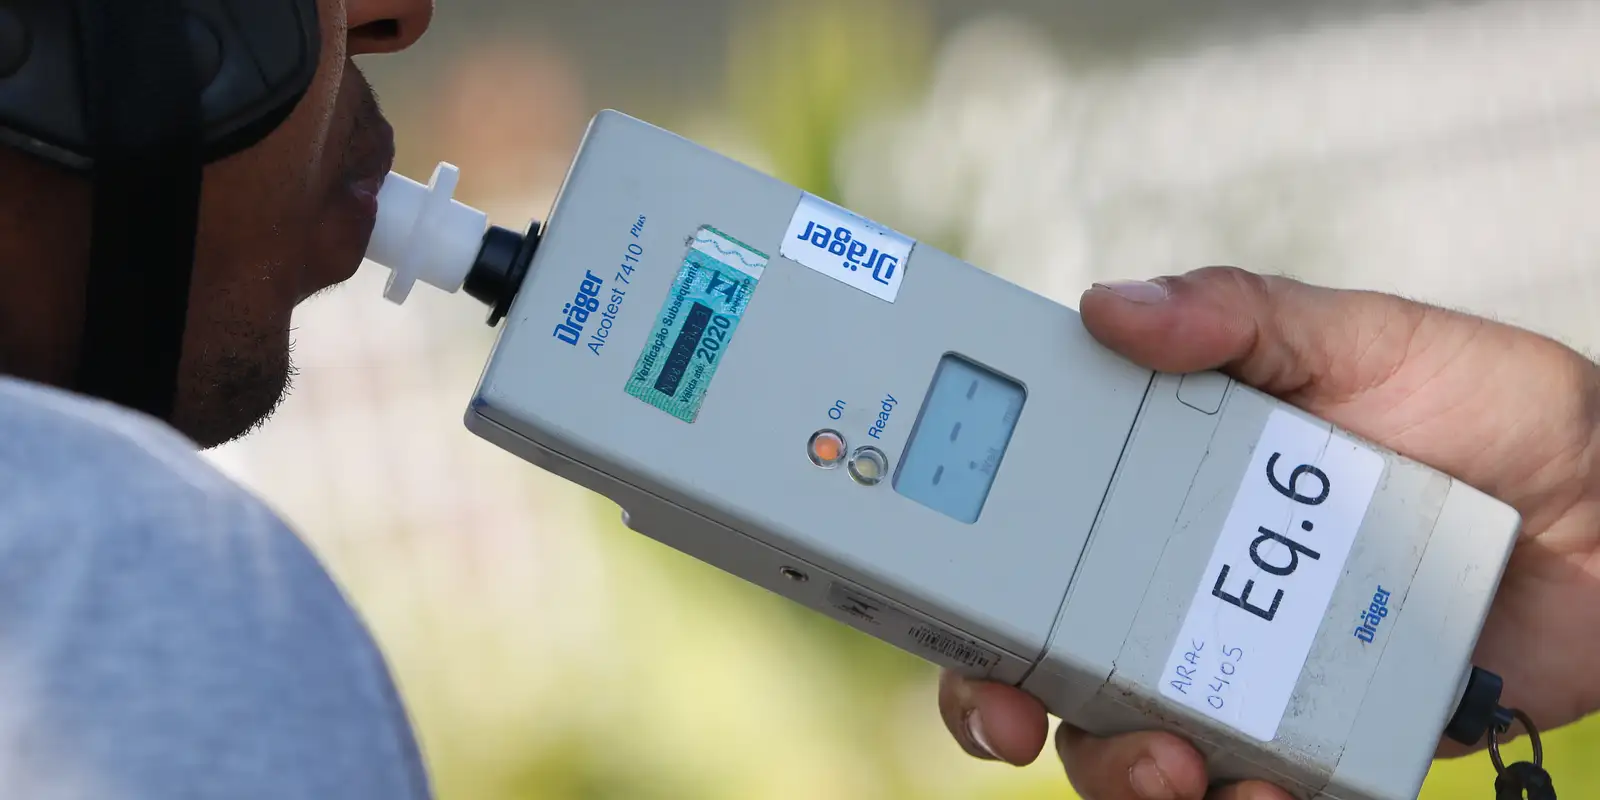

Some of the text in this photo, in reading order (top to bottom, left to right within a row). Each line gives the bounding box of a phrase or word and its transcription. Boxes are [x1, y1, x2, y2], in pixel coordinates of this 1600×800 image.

[587, 214, 646, 356] Alcotest 7410 Plus
[797, 220, 898, 286] Dräger
[553, 269, 603, 346] Dräger
[635, 261, 701, 382] Verificação Subsequente
[680, 379, 698, 403] Válida
[697, 315, 731, 364] 2020
[828, 398, 846, 420] On
[868, 394, 898, 439] Ready
[1212, 452, 1331, 621] Eq.6
[1354, 585, 1391, 644] Dräger
[1207, 645, 1243, 709] 0405
